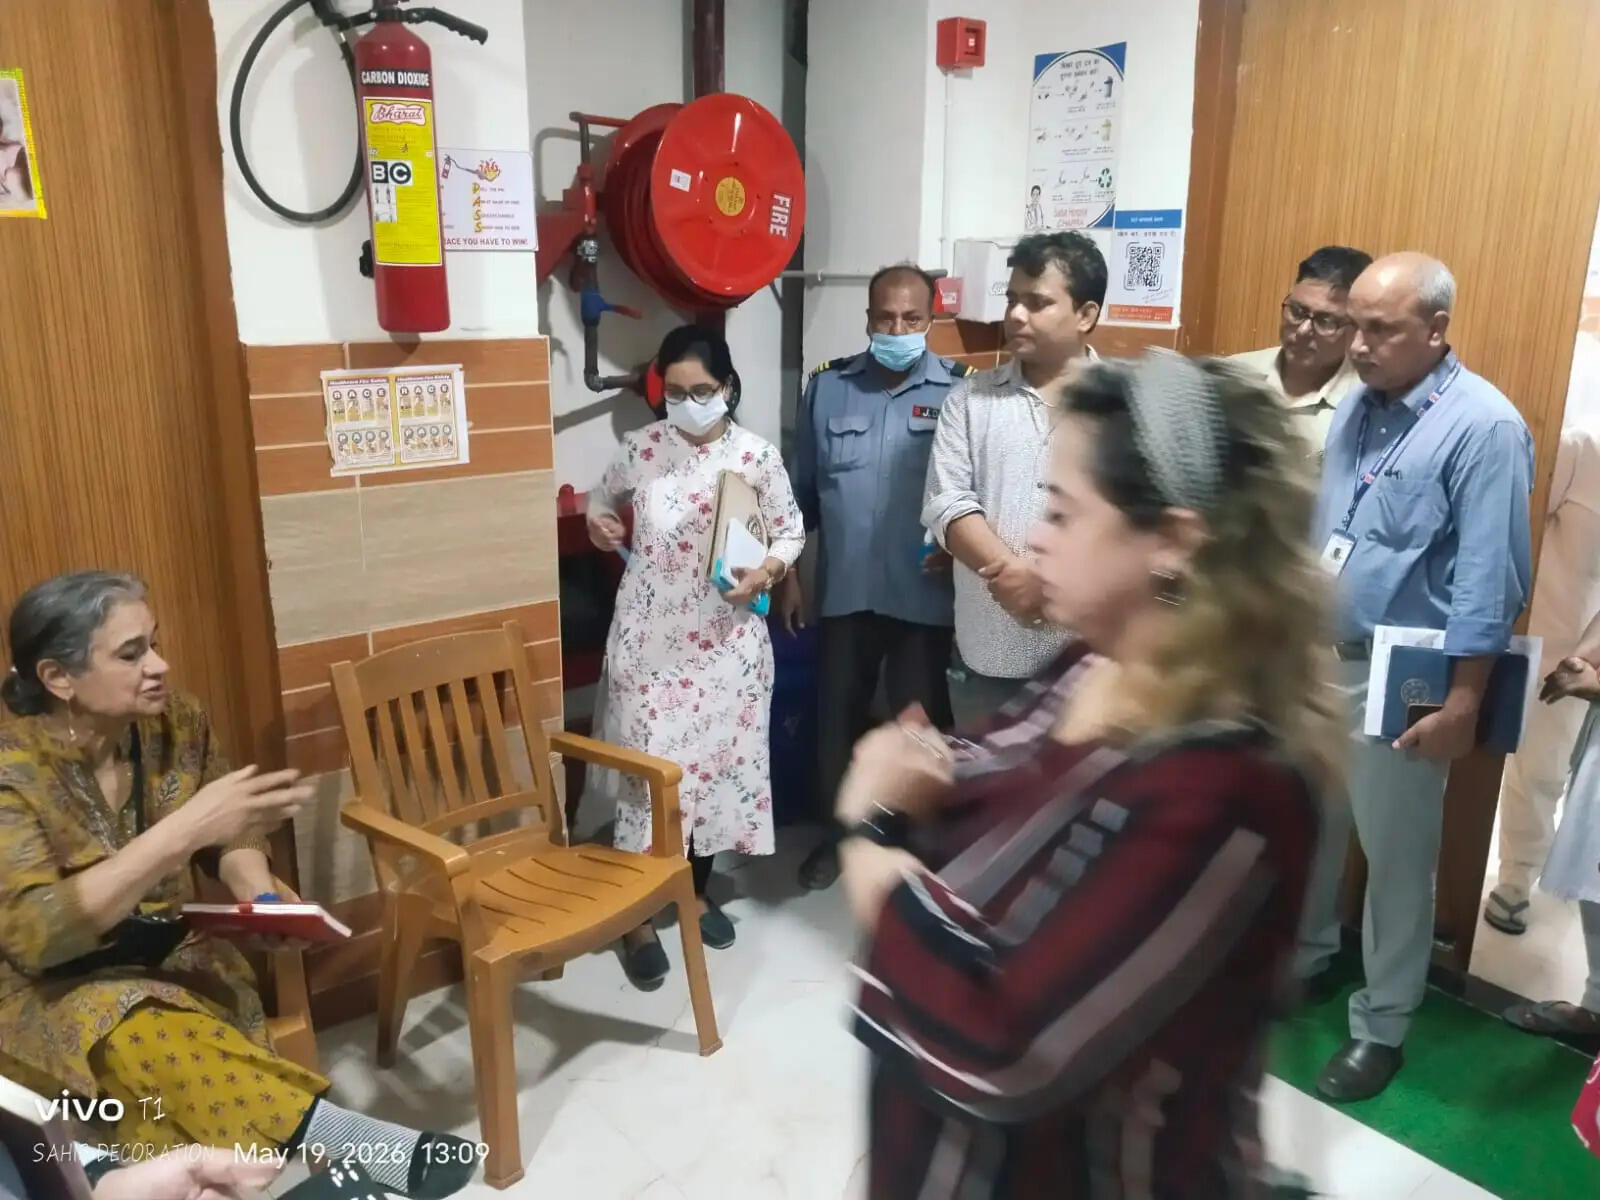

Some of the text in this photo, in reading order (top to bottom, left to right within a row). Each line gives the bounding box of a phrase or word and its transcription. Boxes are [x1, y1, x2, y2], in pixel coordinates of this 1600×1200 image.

[361, 71, 430, 87] CARBON DIOXIDE
[373, 104, 423, 121] Bharat
[769, 193, 792, 237] FIRE
[463, 238, 478, 246] YOU
[480, 238, 499, 246] HAVE
[501, 238, 511, 246] TO
